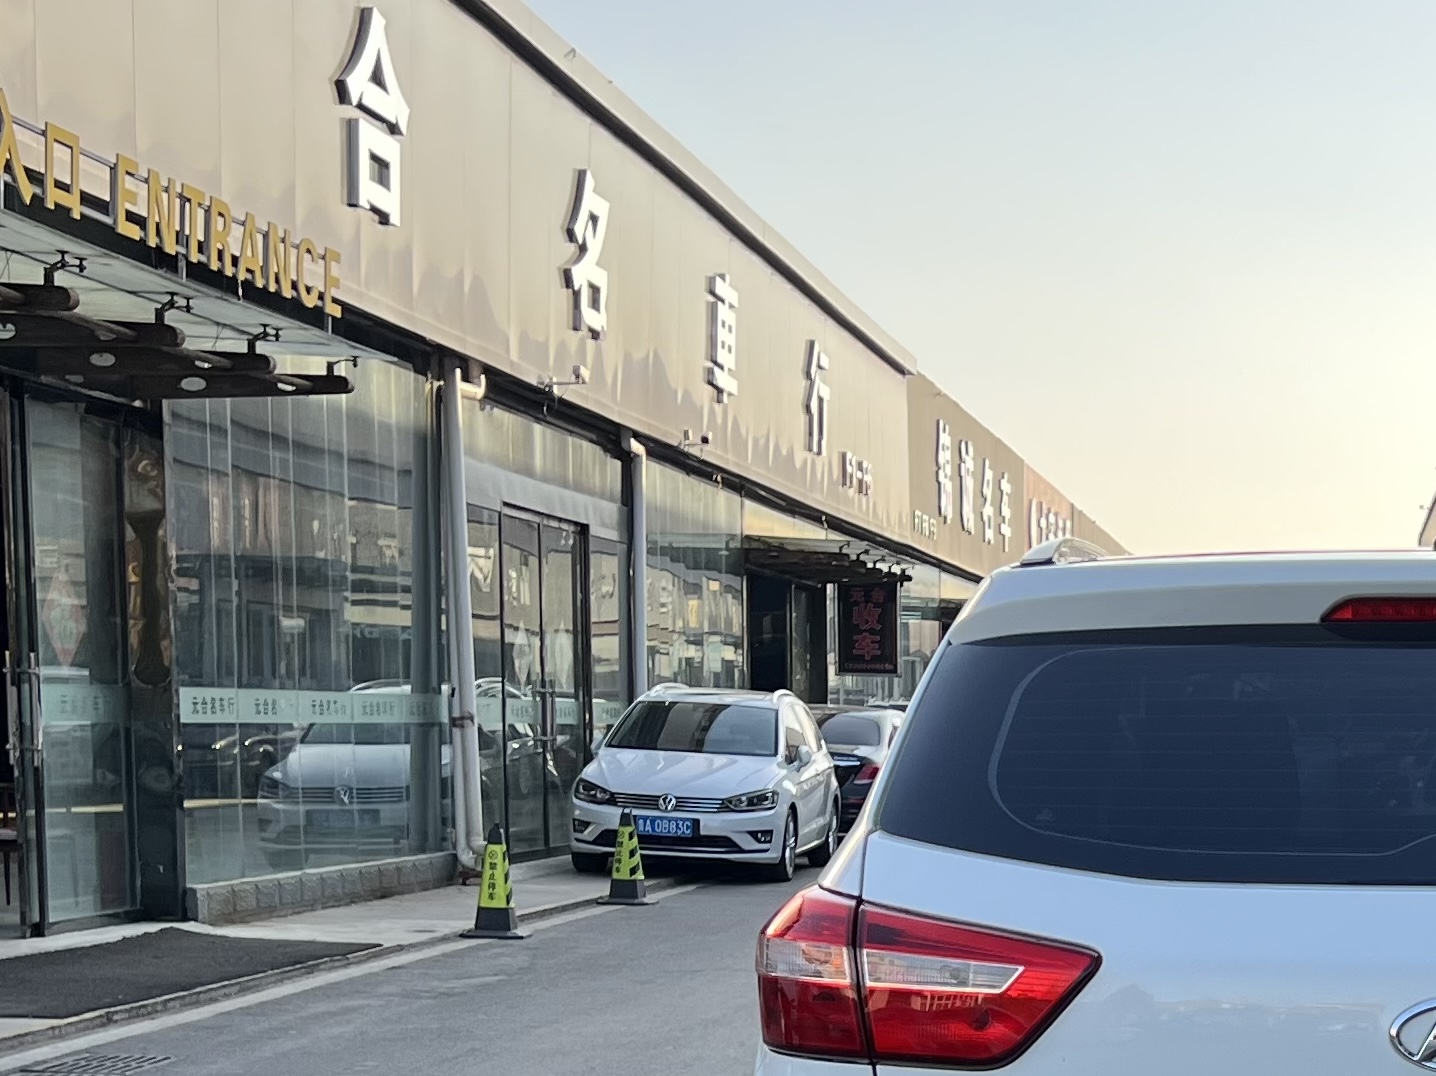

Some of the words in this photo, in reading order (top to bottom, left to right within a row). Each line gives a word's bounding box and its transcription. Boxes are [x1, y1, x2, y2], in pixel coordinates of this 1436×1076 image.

[113, 152, 343, 318] ENTRANCE
[487, 861, 498, 901] 禁止停车
